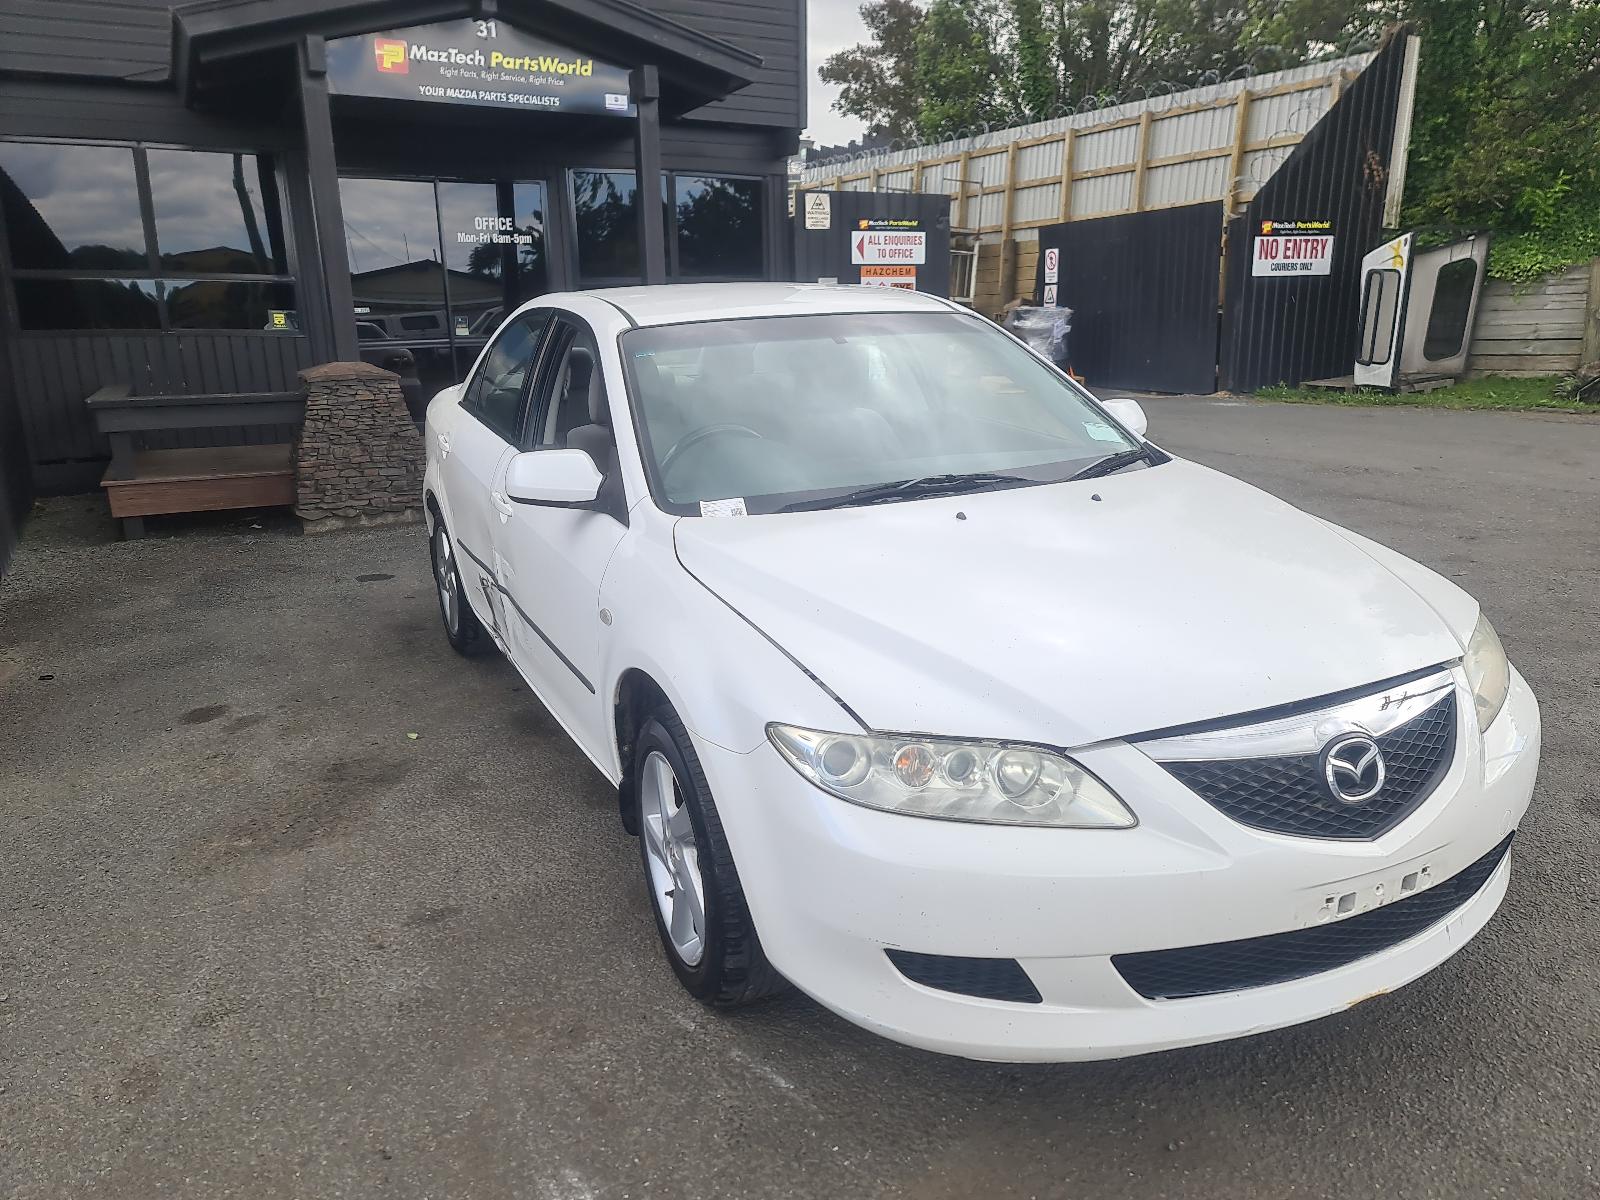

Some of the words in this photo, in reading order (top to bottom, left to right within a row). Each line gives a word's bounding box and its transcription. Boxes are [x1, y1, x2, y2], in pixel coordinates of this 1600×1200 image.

[476, 19, 497, 38] 31
[410, 44, 485, 67] MazTech
[490, 51, 593, 77] PartsWorld
[440, 66, 458, 78] Right
[460, 68, 479, 79] Parts,
[481, 70, 499, 81] Right
[500, 72, 527, 83] Service,
[529, 74, 547, 85] Right
[548, 76, 565, 86] Price
[419, 85, 445, 97] YOUR
[446, 87, 478, 100] MAZDA
[479, 91, 507, 102] PARTS
[507, 94, 560, 106] SPECIALISTS
[474, 216, 514, 231] OFFICE
[457, 232, 491, 244] Mon-Fri
[492, 233, 533, 245] 8am-5pm
[868, 235, 882, 246] ALL
[883, 235, 923, 246] ENQUIRIES
[878, 248, 887, 259] TO
[888, 248, 914, 259] OFFICE
[1259, 238, 1279, 260] NO
[1283, 238, 1328, 260] ENTRY
[865, 267, 912, 276] HAZCHEM
[1271, 262, 1298, 272] COURIERS
[1299, 262, 1313, 271] ONLY
